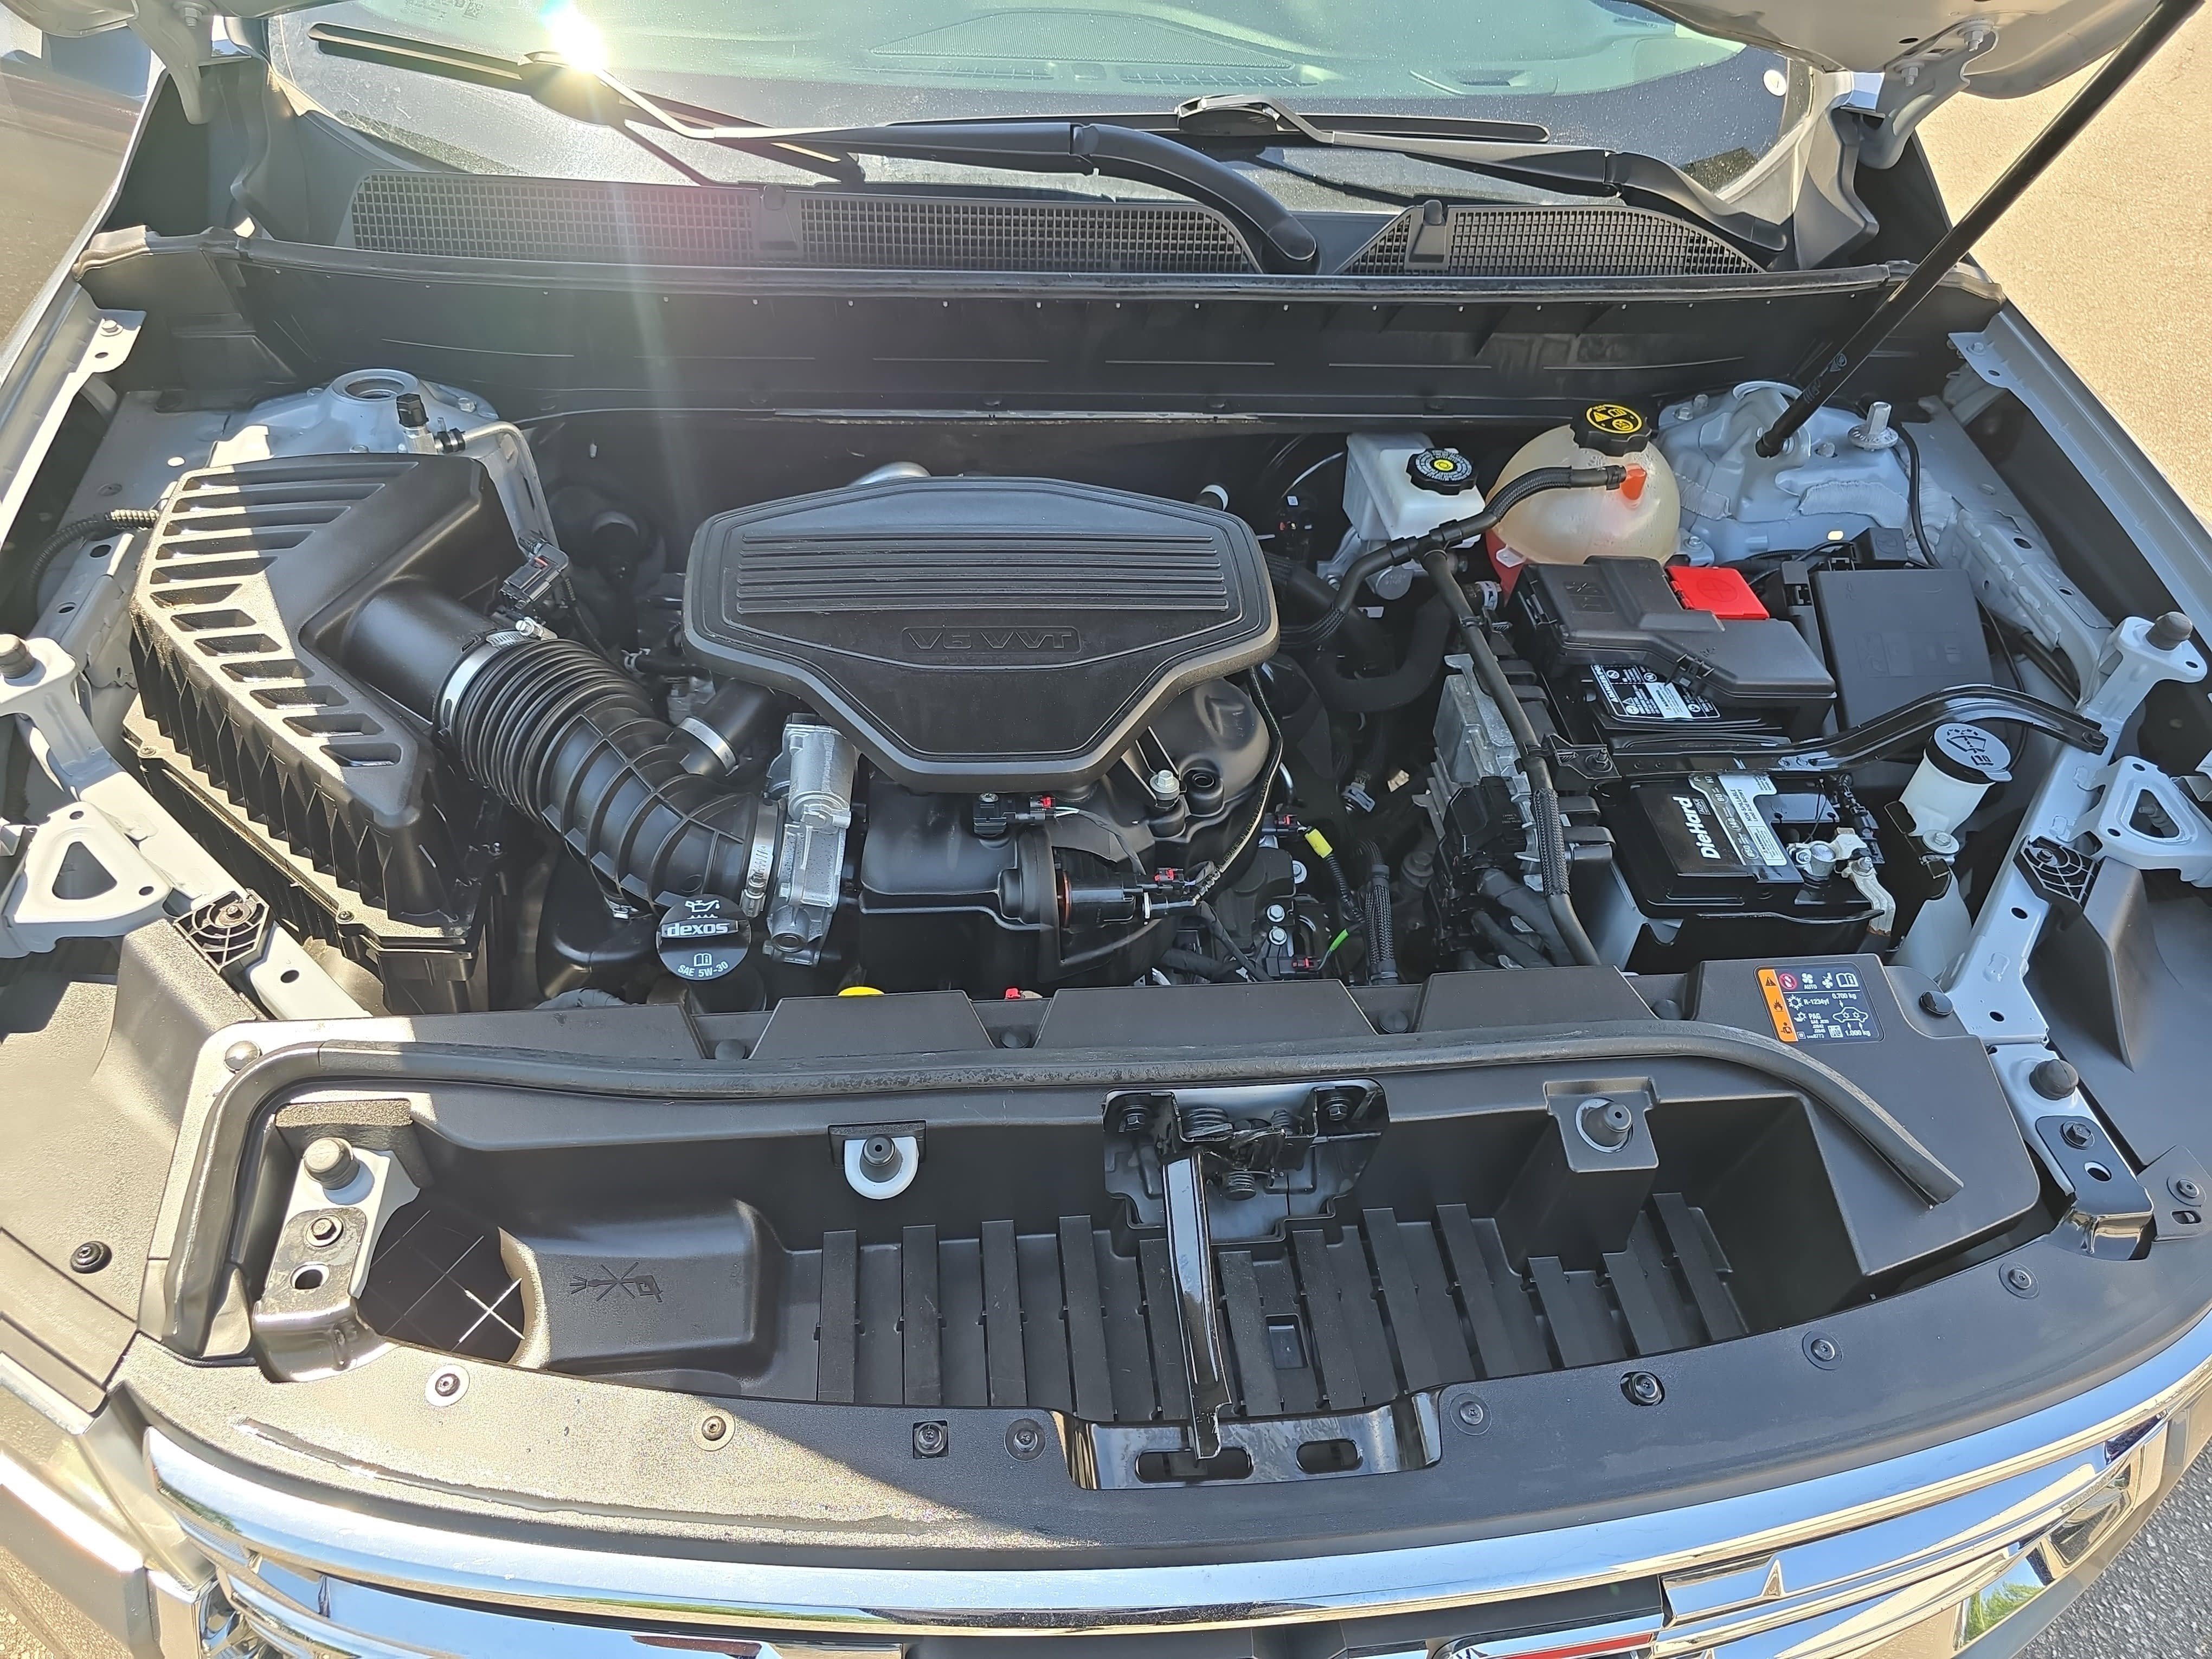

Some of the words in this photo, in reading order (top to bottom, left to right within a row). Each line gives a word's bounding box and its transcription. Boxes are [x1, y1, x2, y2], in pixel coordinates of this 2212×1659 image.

[909, 632, 972, 650] V6
[980, 631, 1072, 650] VVT
[1672, 796, 1721, 859] DieHard
[1742, 845, 1755, 858] 850
[667, 923, 730, 937] dexos
[678, 964, 695, 977] SAE
[698, 961, 729, 978] 5W-30
